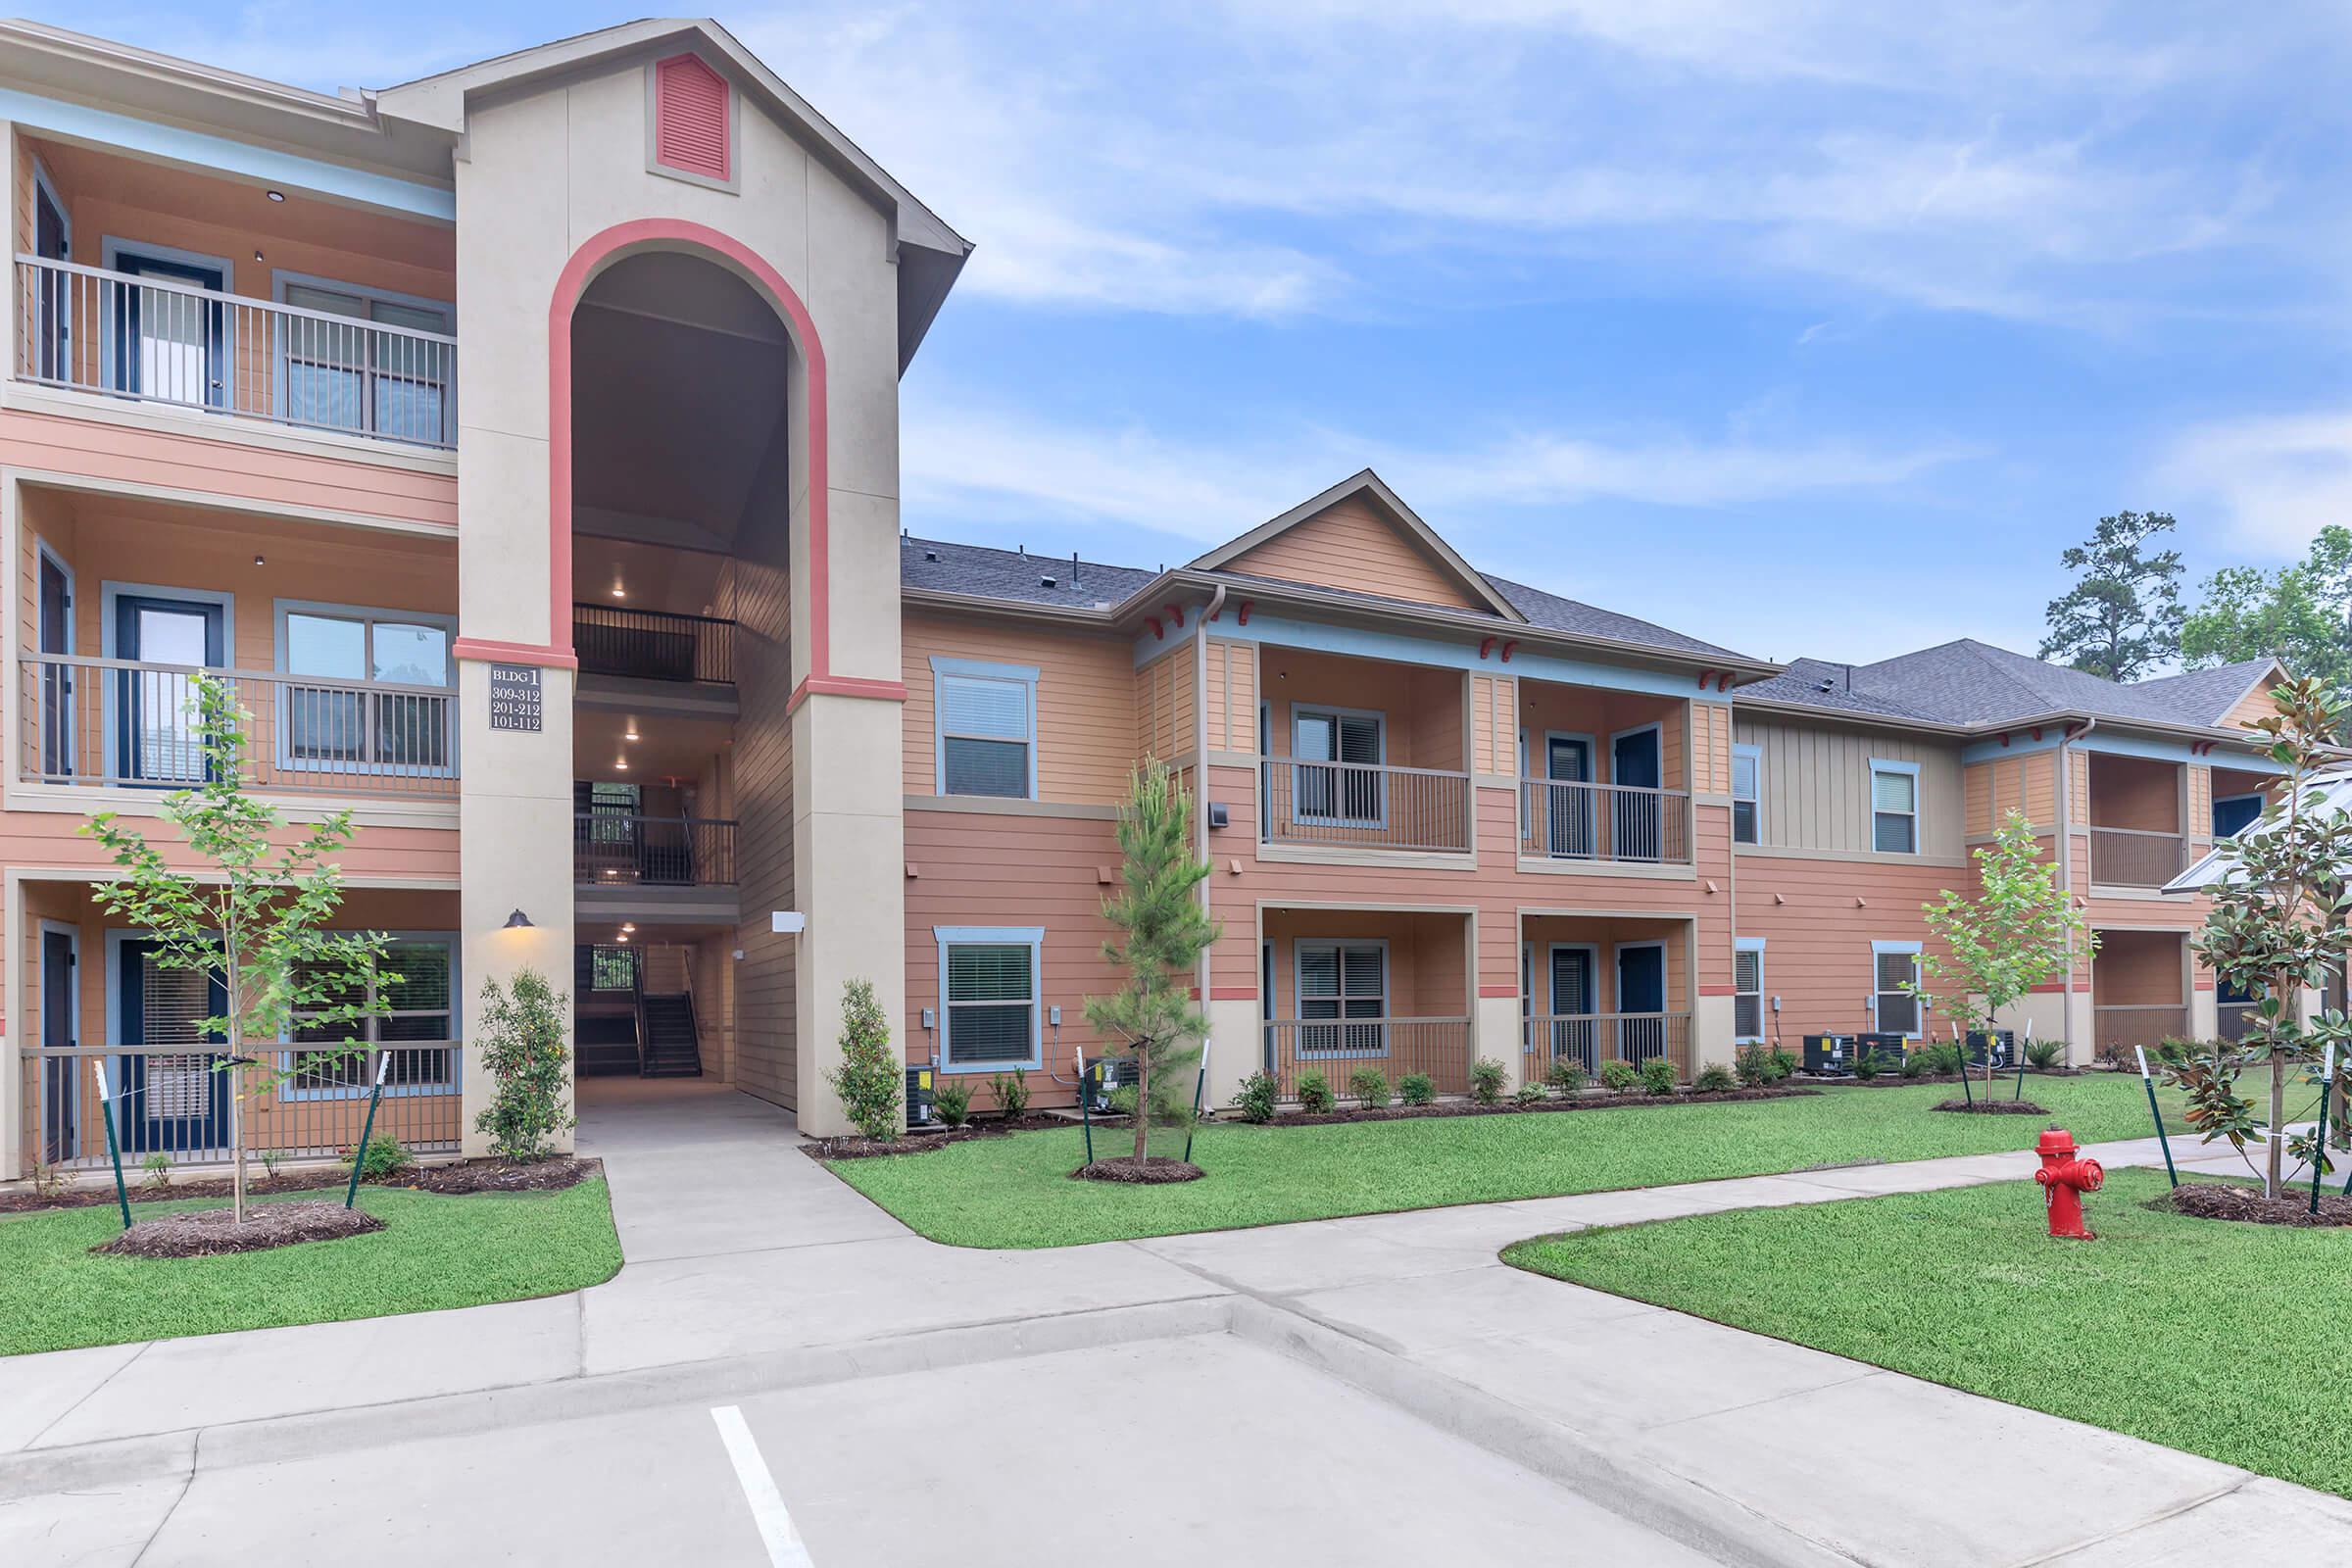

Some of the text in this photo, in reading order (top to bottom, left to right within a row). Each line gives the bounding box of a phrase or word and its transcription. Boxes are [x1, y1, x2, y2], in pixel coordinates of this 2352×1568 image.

[493, 669, 539, 686] BLDG 1
[492, 686, 540, 703] 309-312
[492, 701, 540, 716] 201-212
[493, 715, 540, 730] 101-112
